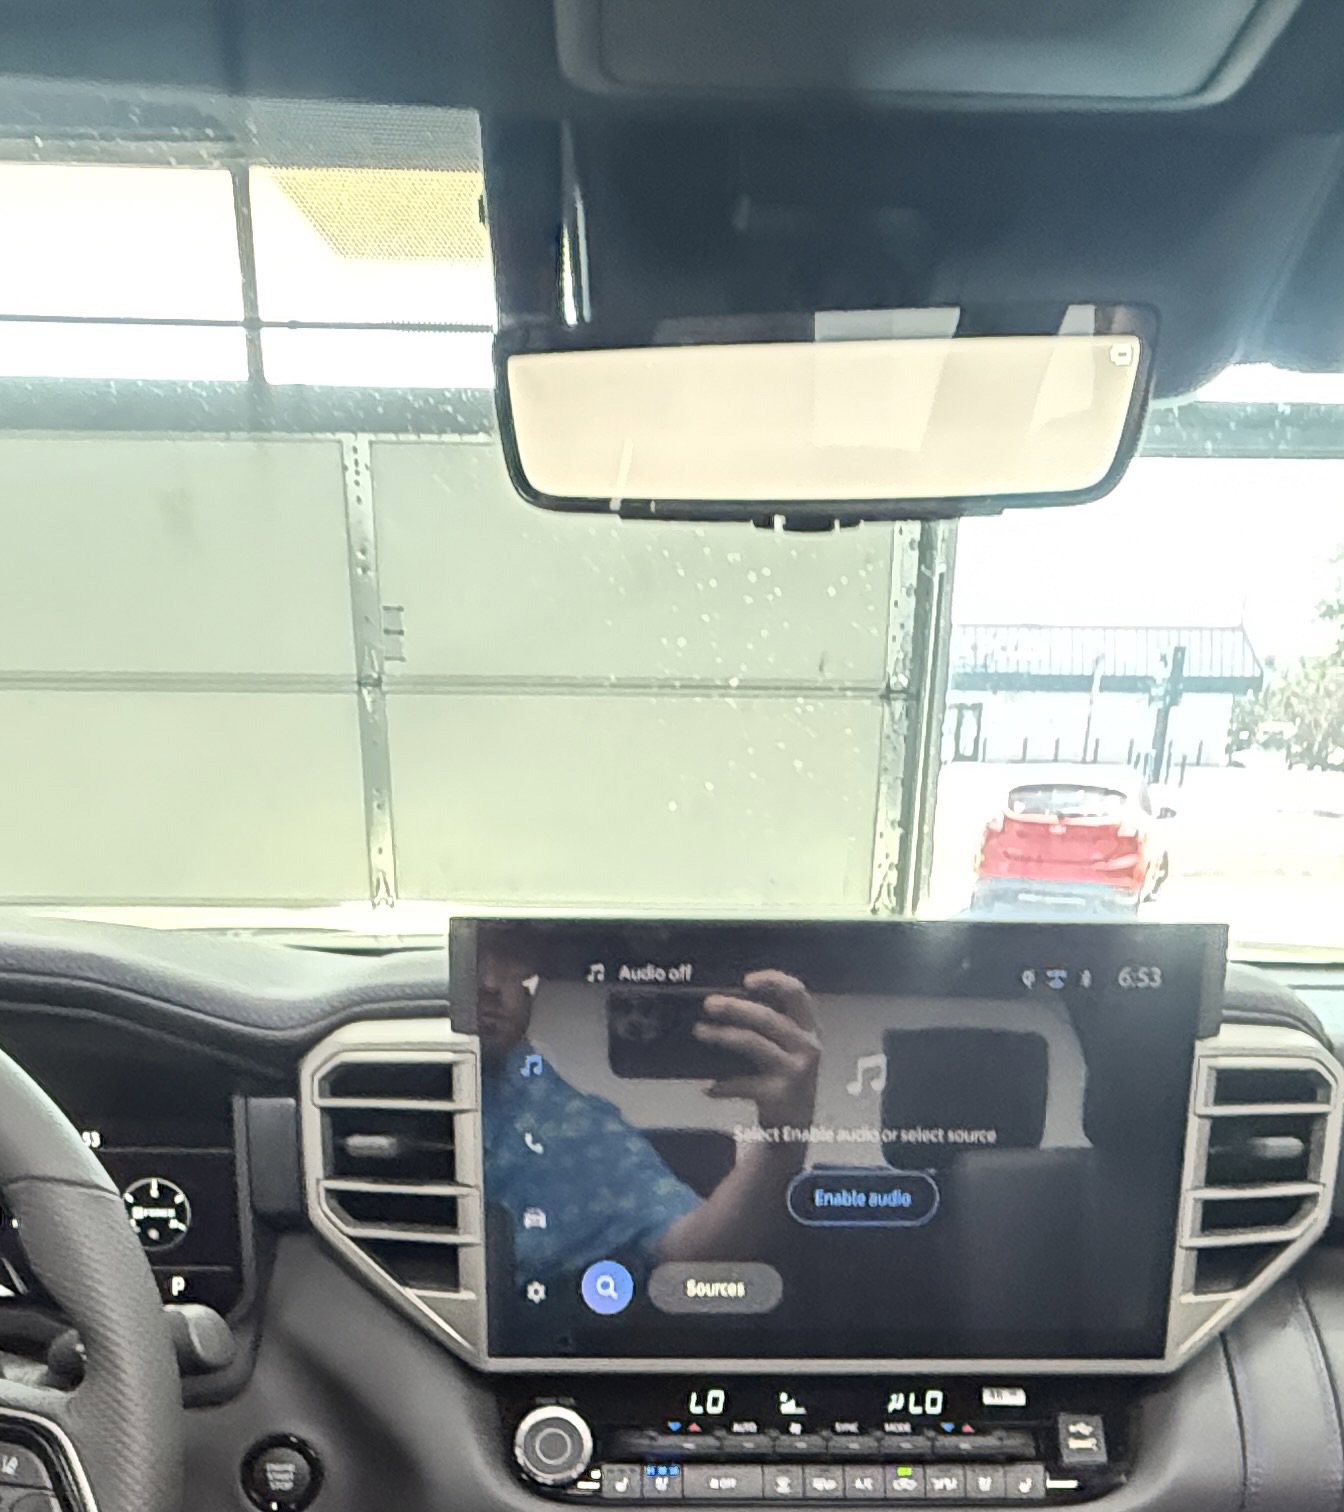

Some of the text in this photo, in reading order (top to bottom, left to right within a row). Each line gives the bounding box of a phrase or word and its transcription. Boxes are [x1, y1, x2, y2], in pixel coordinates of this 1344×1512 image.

[618, 963, 692, 982] Audio off
[1118, 966, 1161, 988] 6:53
[734, 1125, 996, 1144] Select Enable audio or select source
[814, 1188, 912, 1207] Enable audio
[171, 1276, 186, 1296] P
[686, 1278, 745, 1298] Sources
[689, 1389, 725, 1415] LO
[908, 1389, 944, 1415] LO
